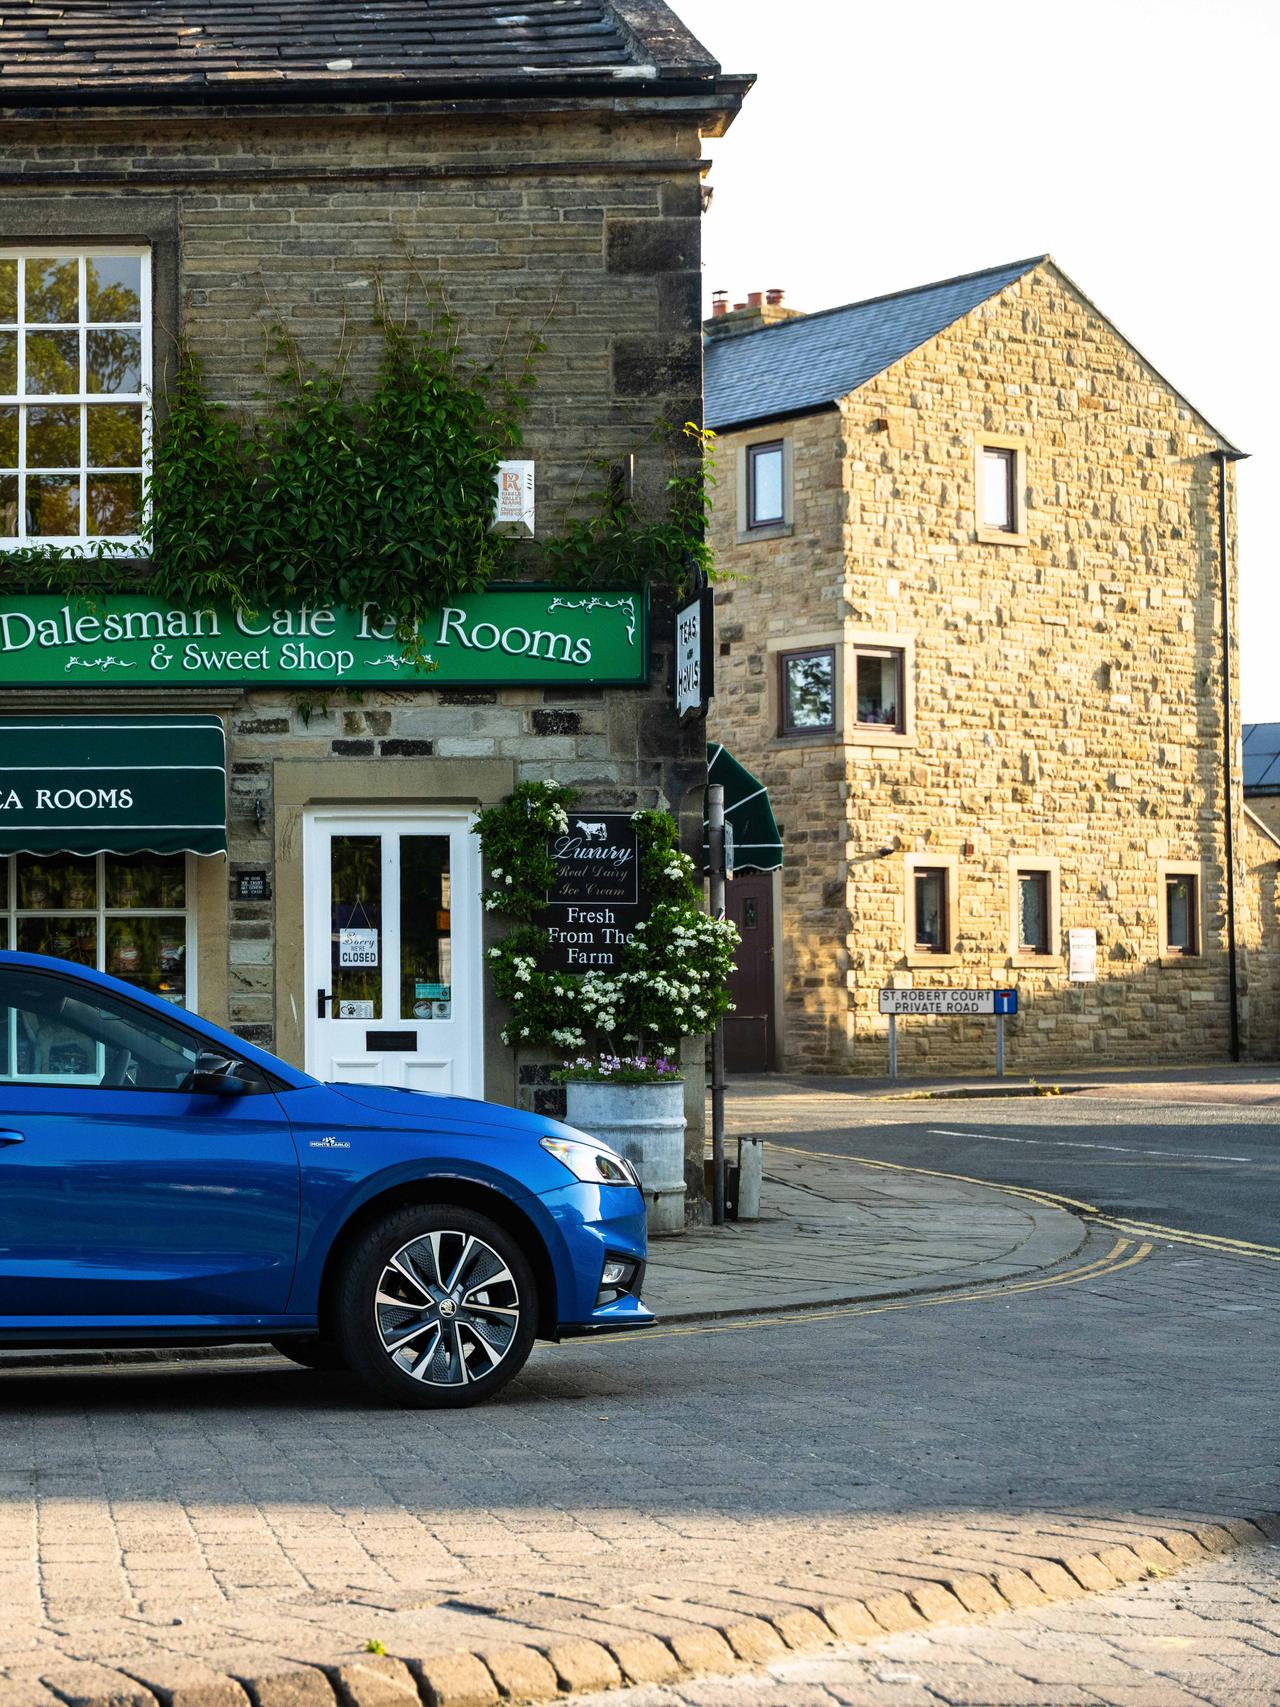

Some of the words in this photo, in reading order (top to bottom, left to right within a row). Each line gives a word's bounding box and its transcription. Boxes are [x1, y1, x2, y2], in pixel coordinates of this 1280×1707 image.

[436, 607, 592, 664] Rooms
[680, 616, 697, 646] TEAS
[150, 643, 173, 670] &
[182, 643, 270, 670] Sweet
[279, 642, 354, 675] Shop
[35, 788, 134, 809] ROOMS
[551, 836, 634, 867] Luxury
[586, 883, 625, 896] Cream
[567, 908, 616, 924] Fresh
[342, 932, 375, 949] Sorry
[548, 928, 594, 943] From
[601, 928, 635, 944] The
[342, 952, 376, 963] CLOSED
[567, 949, 614, 965] Farm
[901, 991, 948, 1001] ROBERT
[951, 991, 992, 1001] COURT
[895, 1002, 942, 1012] PRIVATE
[946, 1002, 979, 1012] ROAD
